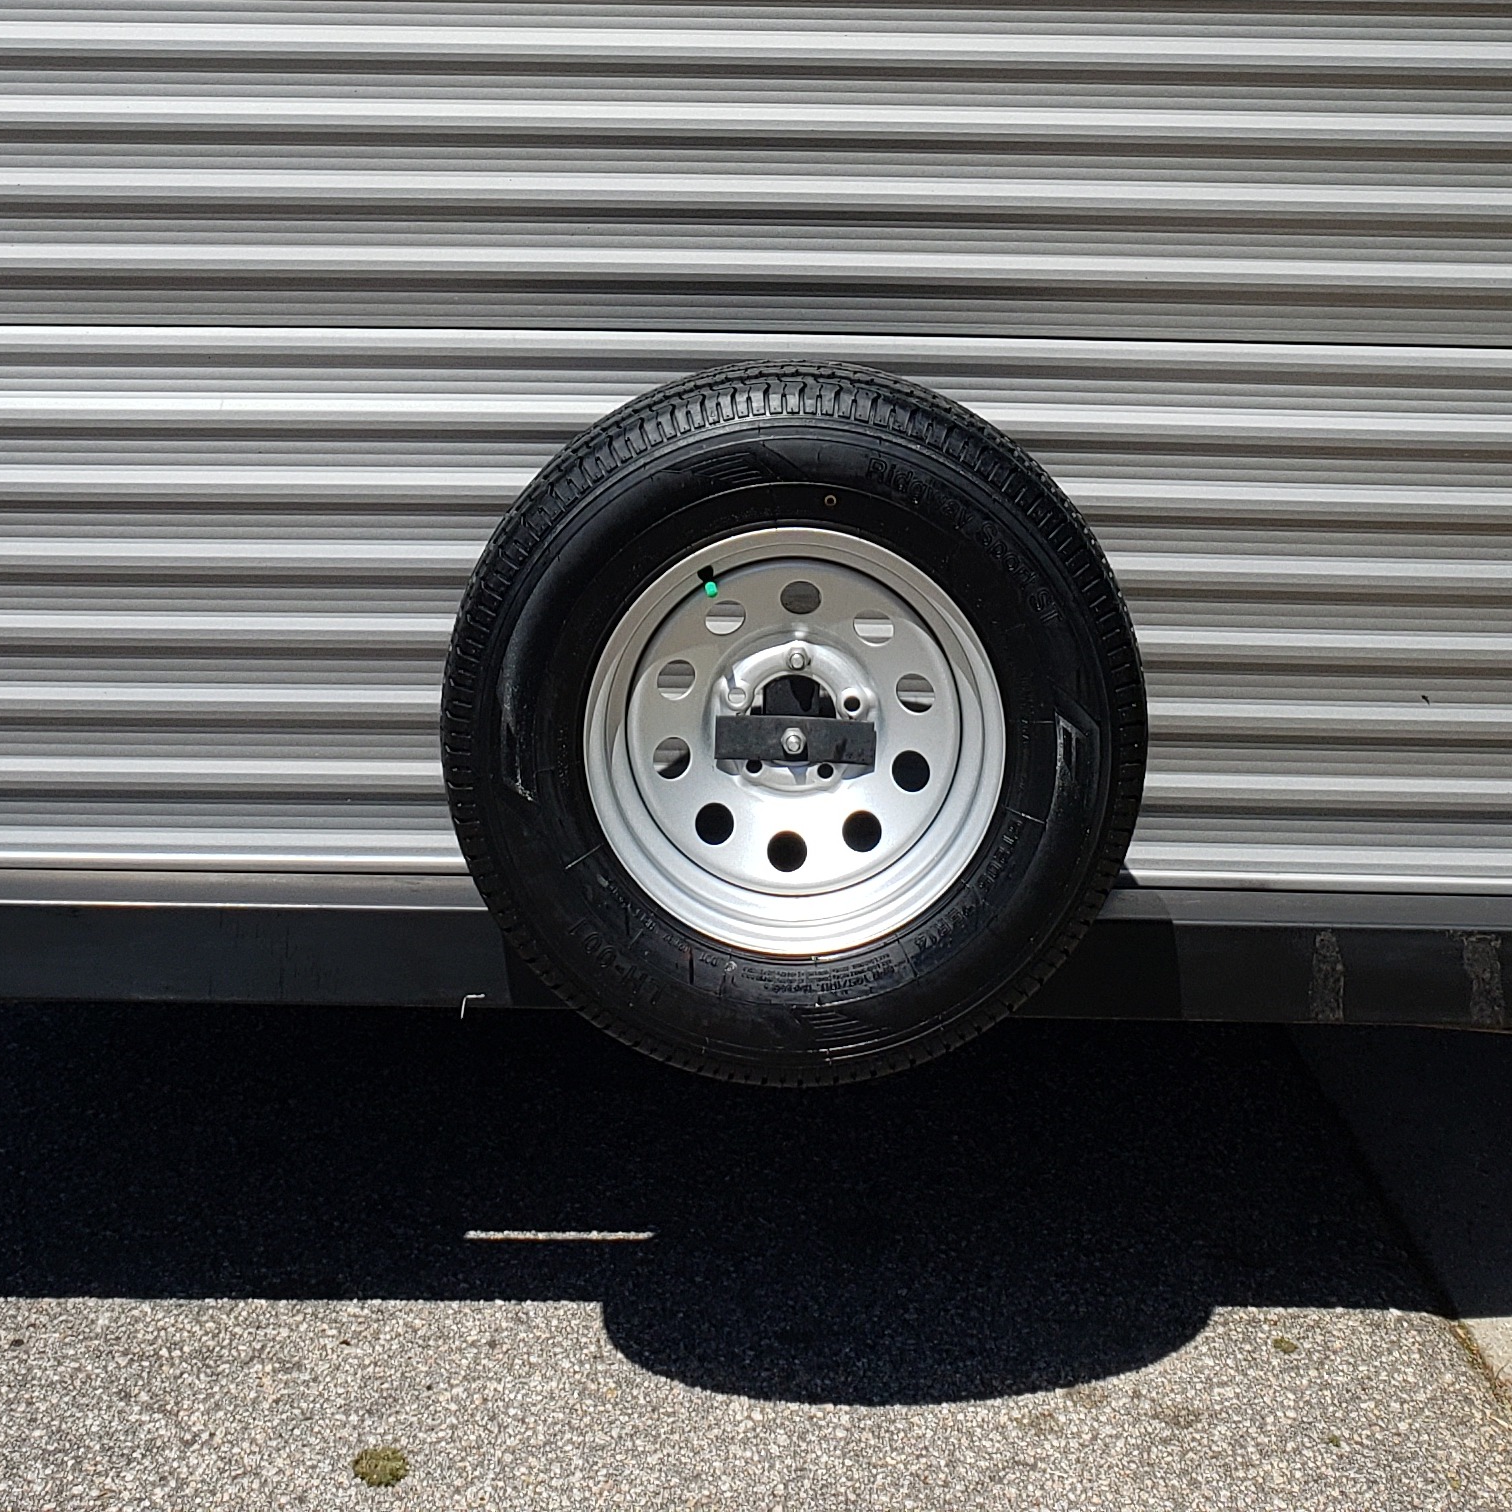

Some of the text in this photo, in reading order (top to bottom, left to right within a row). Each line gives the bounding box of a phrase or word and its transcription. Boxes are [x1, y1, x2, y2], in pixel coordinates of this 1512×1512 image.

[866, 457, 1065, 624] Ridgway Sport ST
